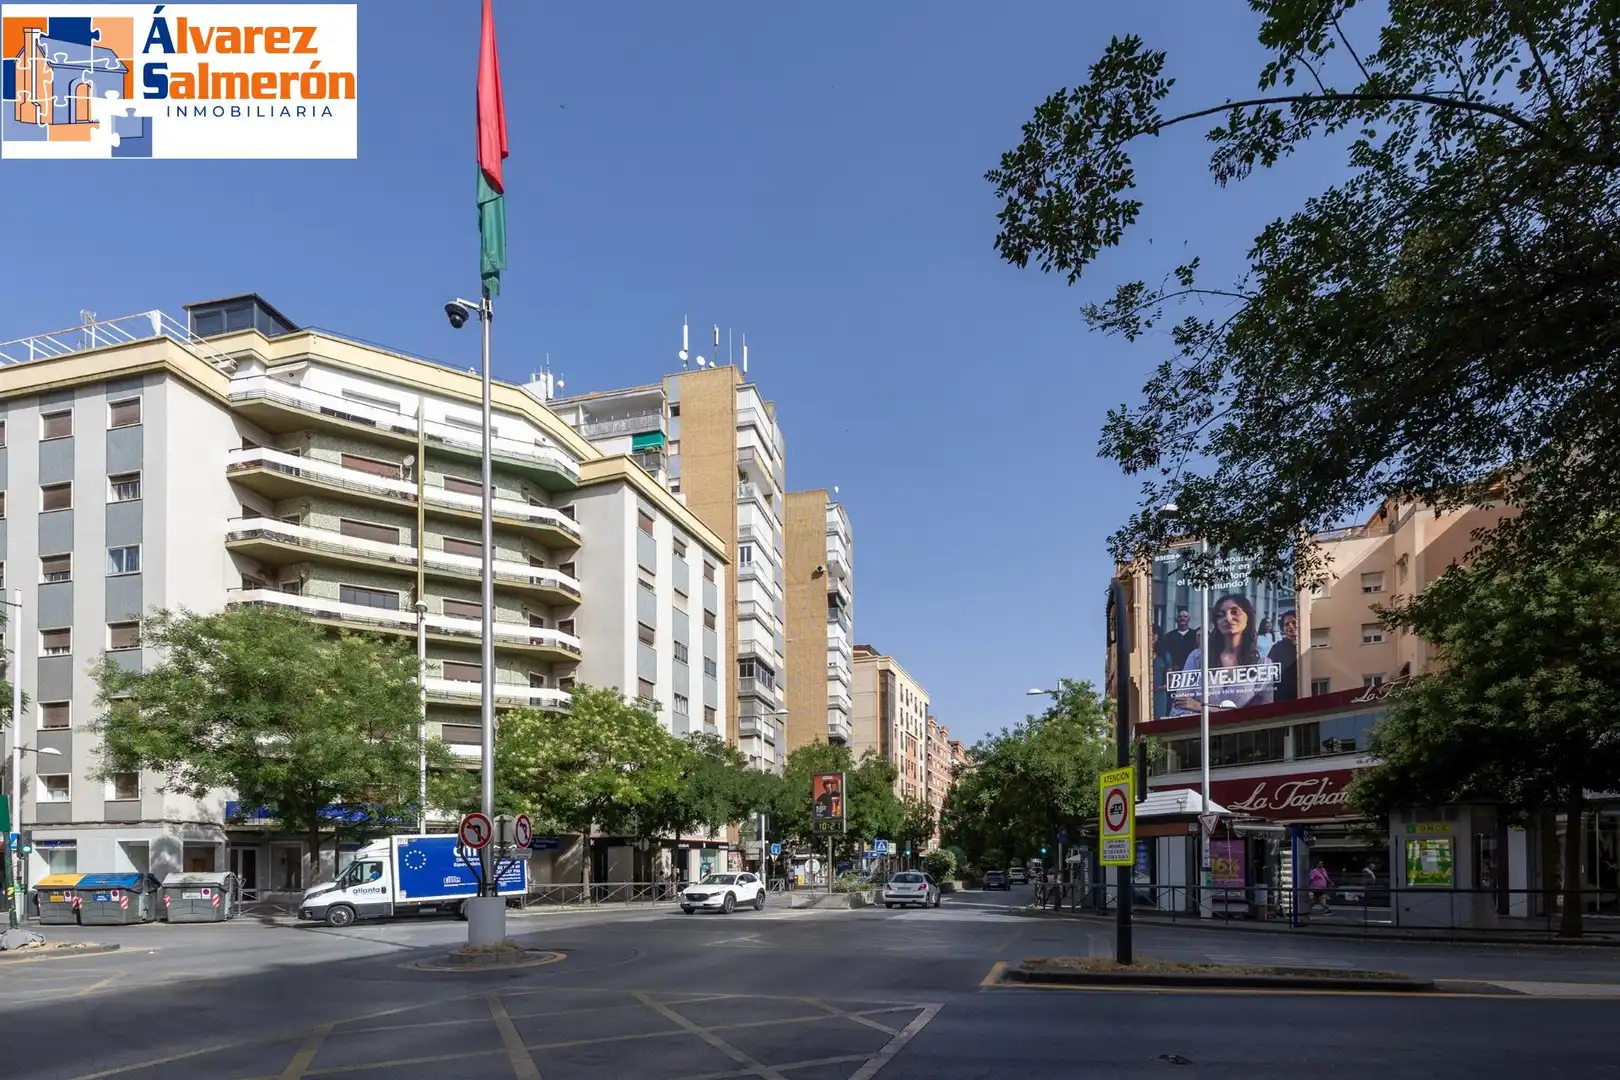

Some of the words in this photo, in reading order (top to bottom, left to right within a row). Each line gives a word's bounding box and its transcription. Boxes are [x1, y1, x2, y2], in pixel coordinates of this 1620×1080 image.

[1211, 579, 1249, 590] mundo?
[1103, 771, 1130, 784] ATENCIÓN
[1227, 782, 1268, 811] La
